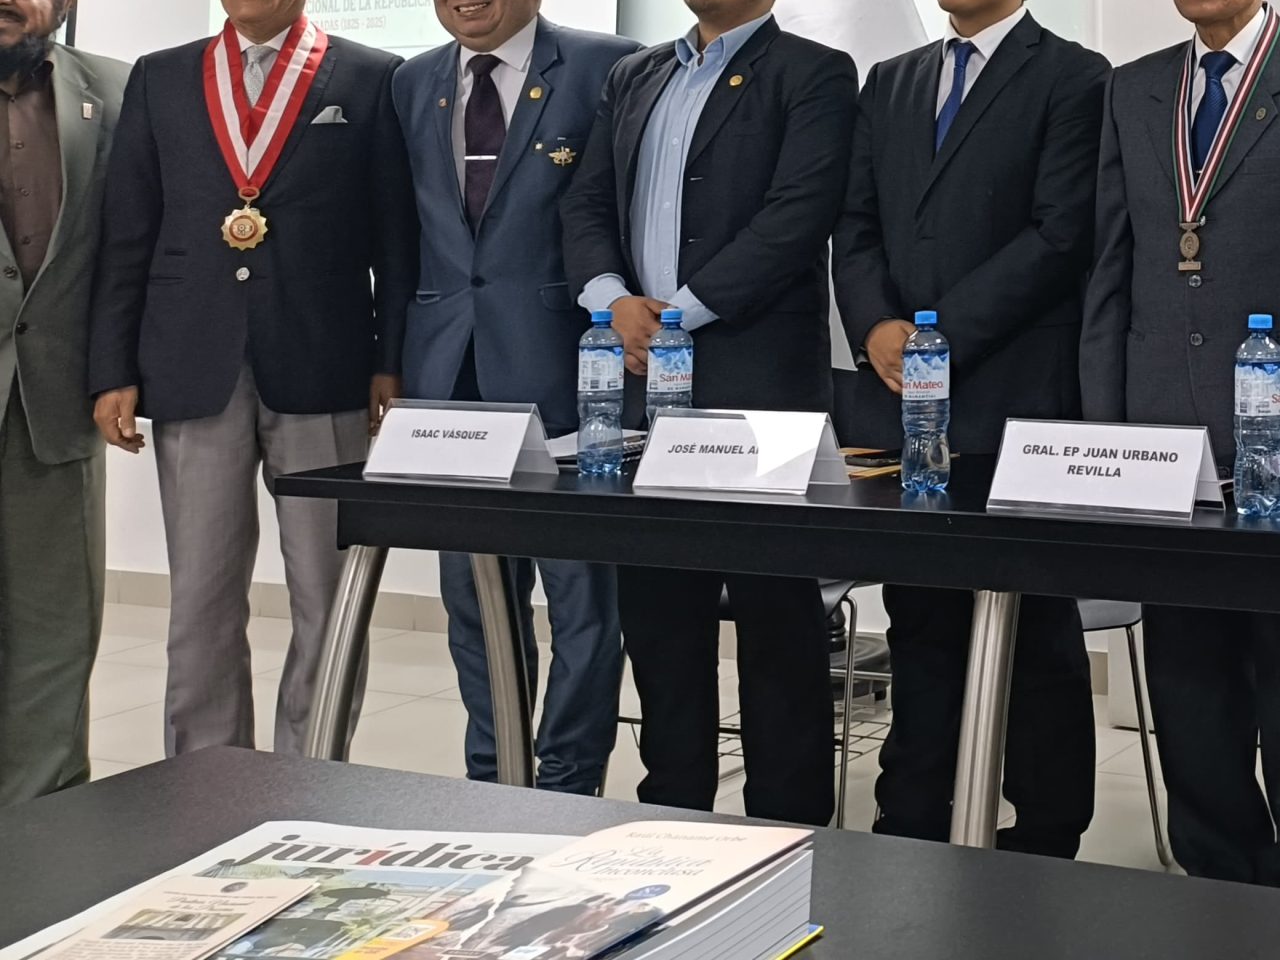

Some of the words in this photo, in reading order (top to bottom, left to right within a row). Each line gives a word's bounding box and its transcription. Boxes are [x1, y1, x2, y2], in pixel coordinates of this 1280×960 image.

[659, 373, 679, 383] San
[912, 380, 944, 390] Mateo
[411, 429, 440, 439] ISAAC
[442, 429, 489, 440] VÁSQUEZ
[667, 443, 697, 454] JOSÉ
[698, 444, 745, 455] MANUEL
[1022, 444, 1059, 457] GRAL.
[1062, 446, 1080, 458] EP
[1082, 447, 1119, 460] JUAN
[1122, 449, 1179, 464] URBANO
[1066, 464, 1122, 478] REVILLA
[216, 834, 535, 871] jurídica
